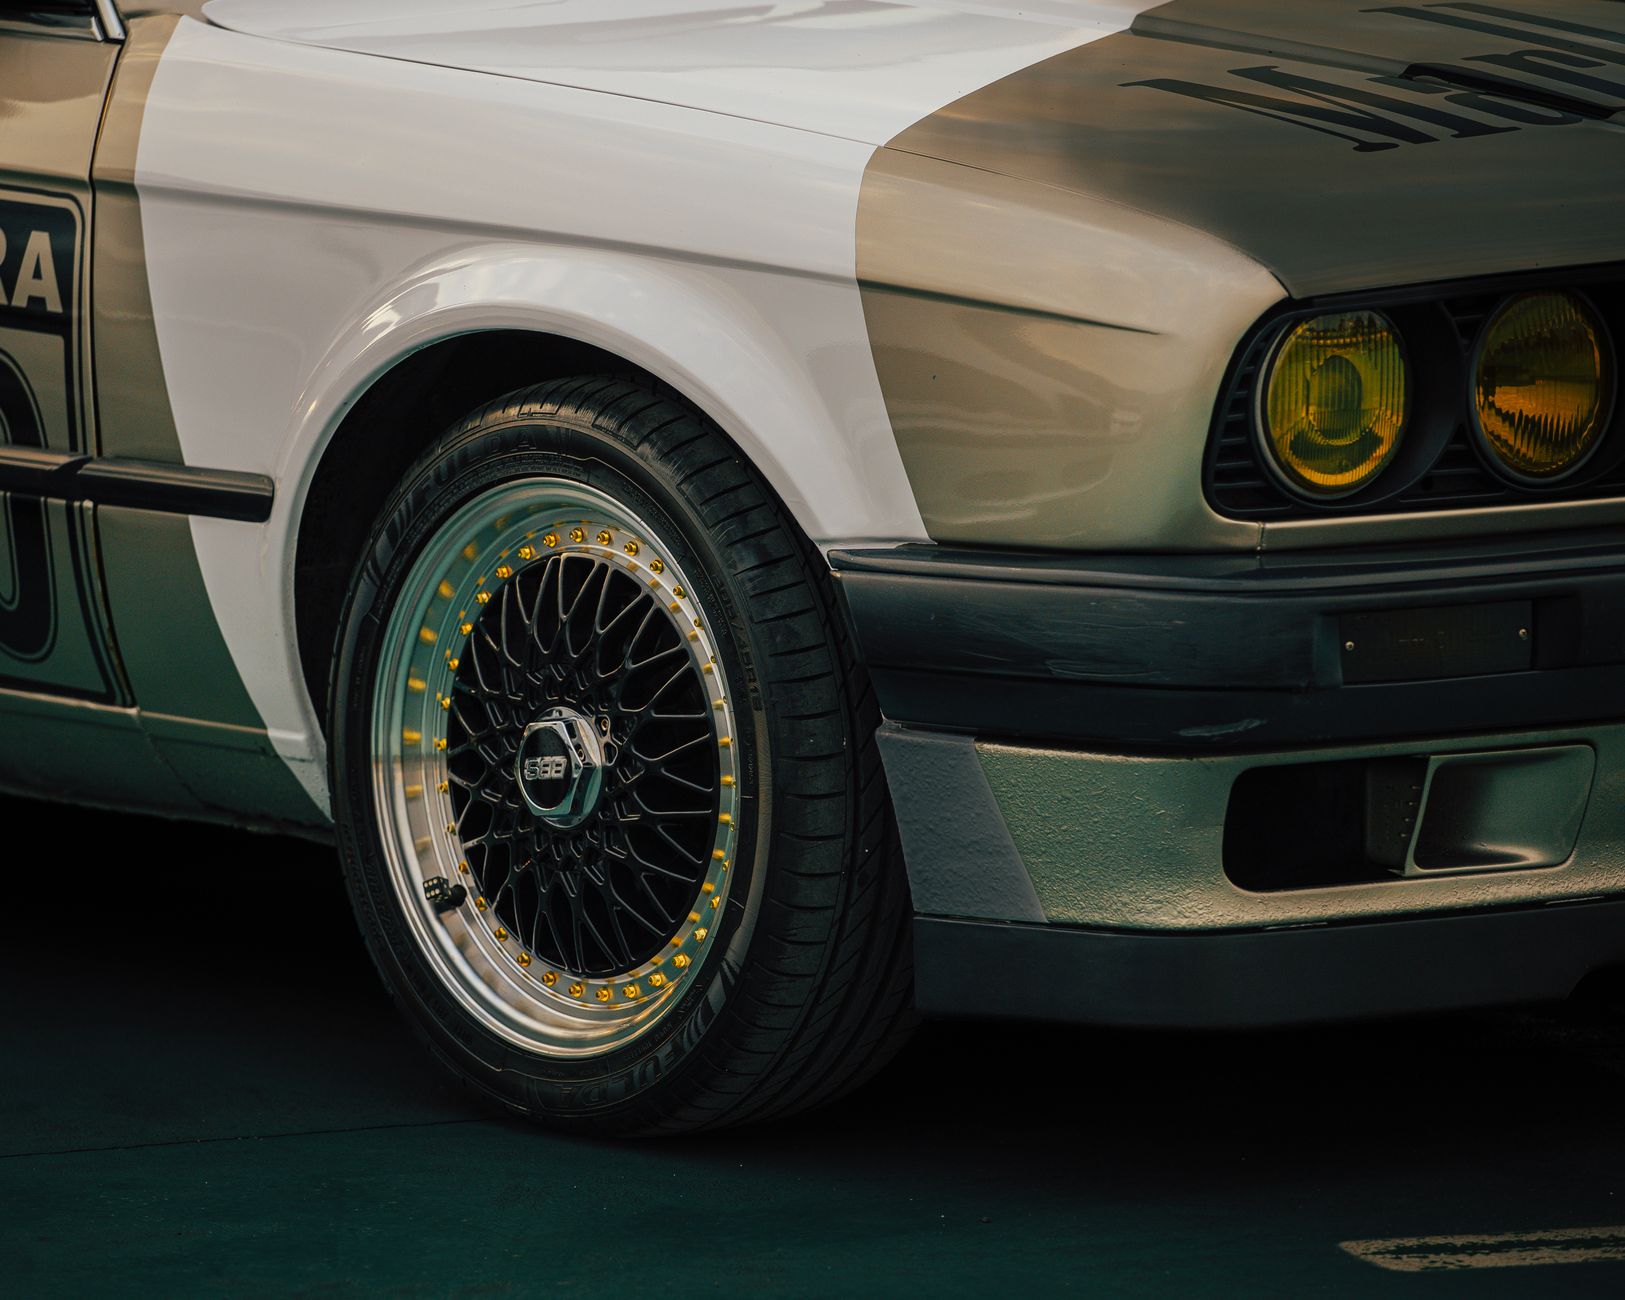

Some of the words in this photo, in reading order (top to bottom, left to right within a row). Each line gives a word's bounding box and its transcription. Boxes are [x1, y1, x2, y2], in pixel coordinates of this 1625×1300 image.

[0, 226, 64, 314] A
[416, 429, 537, 503] FULDA
[559, 1042, 678, 1107] FULDA
